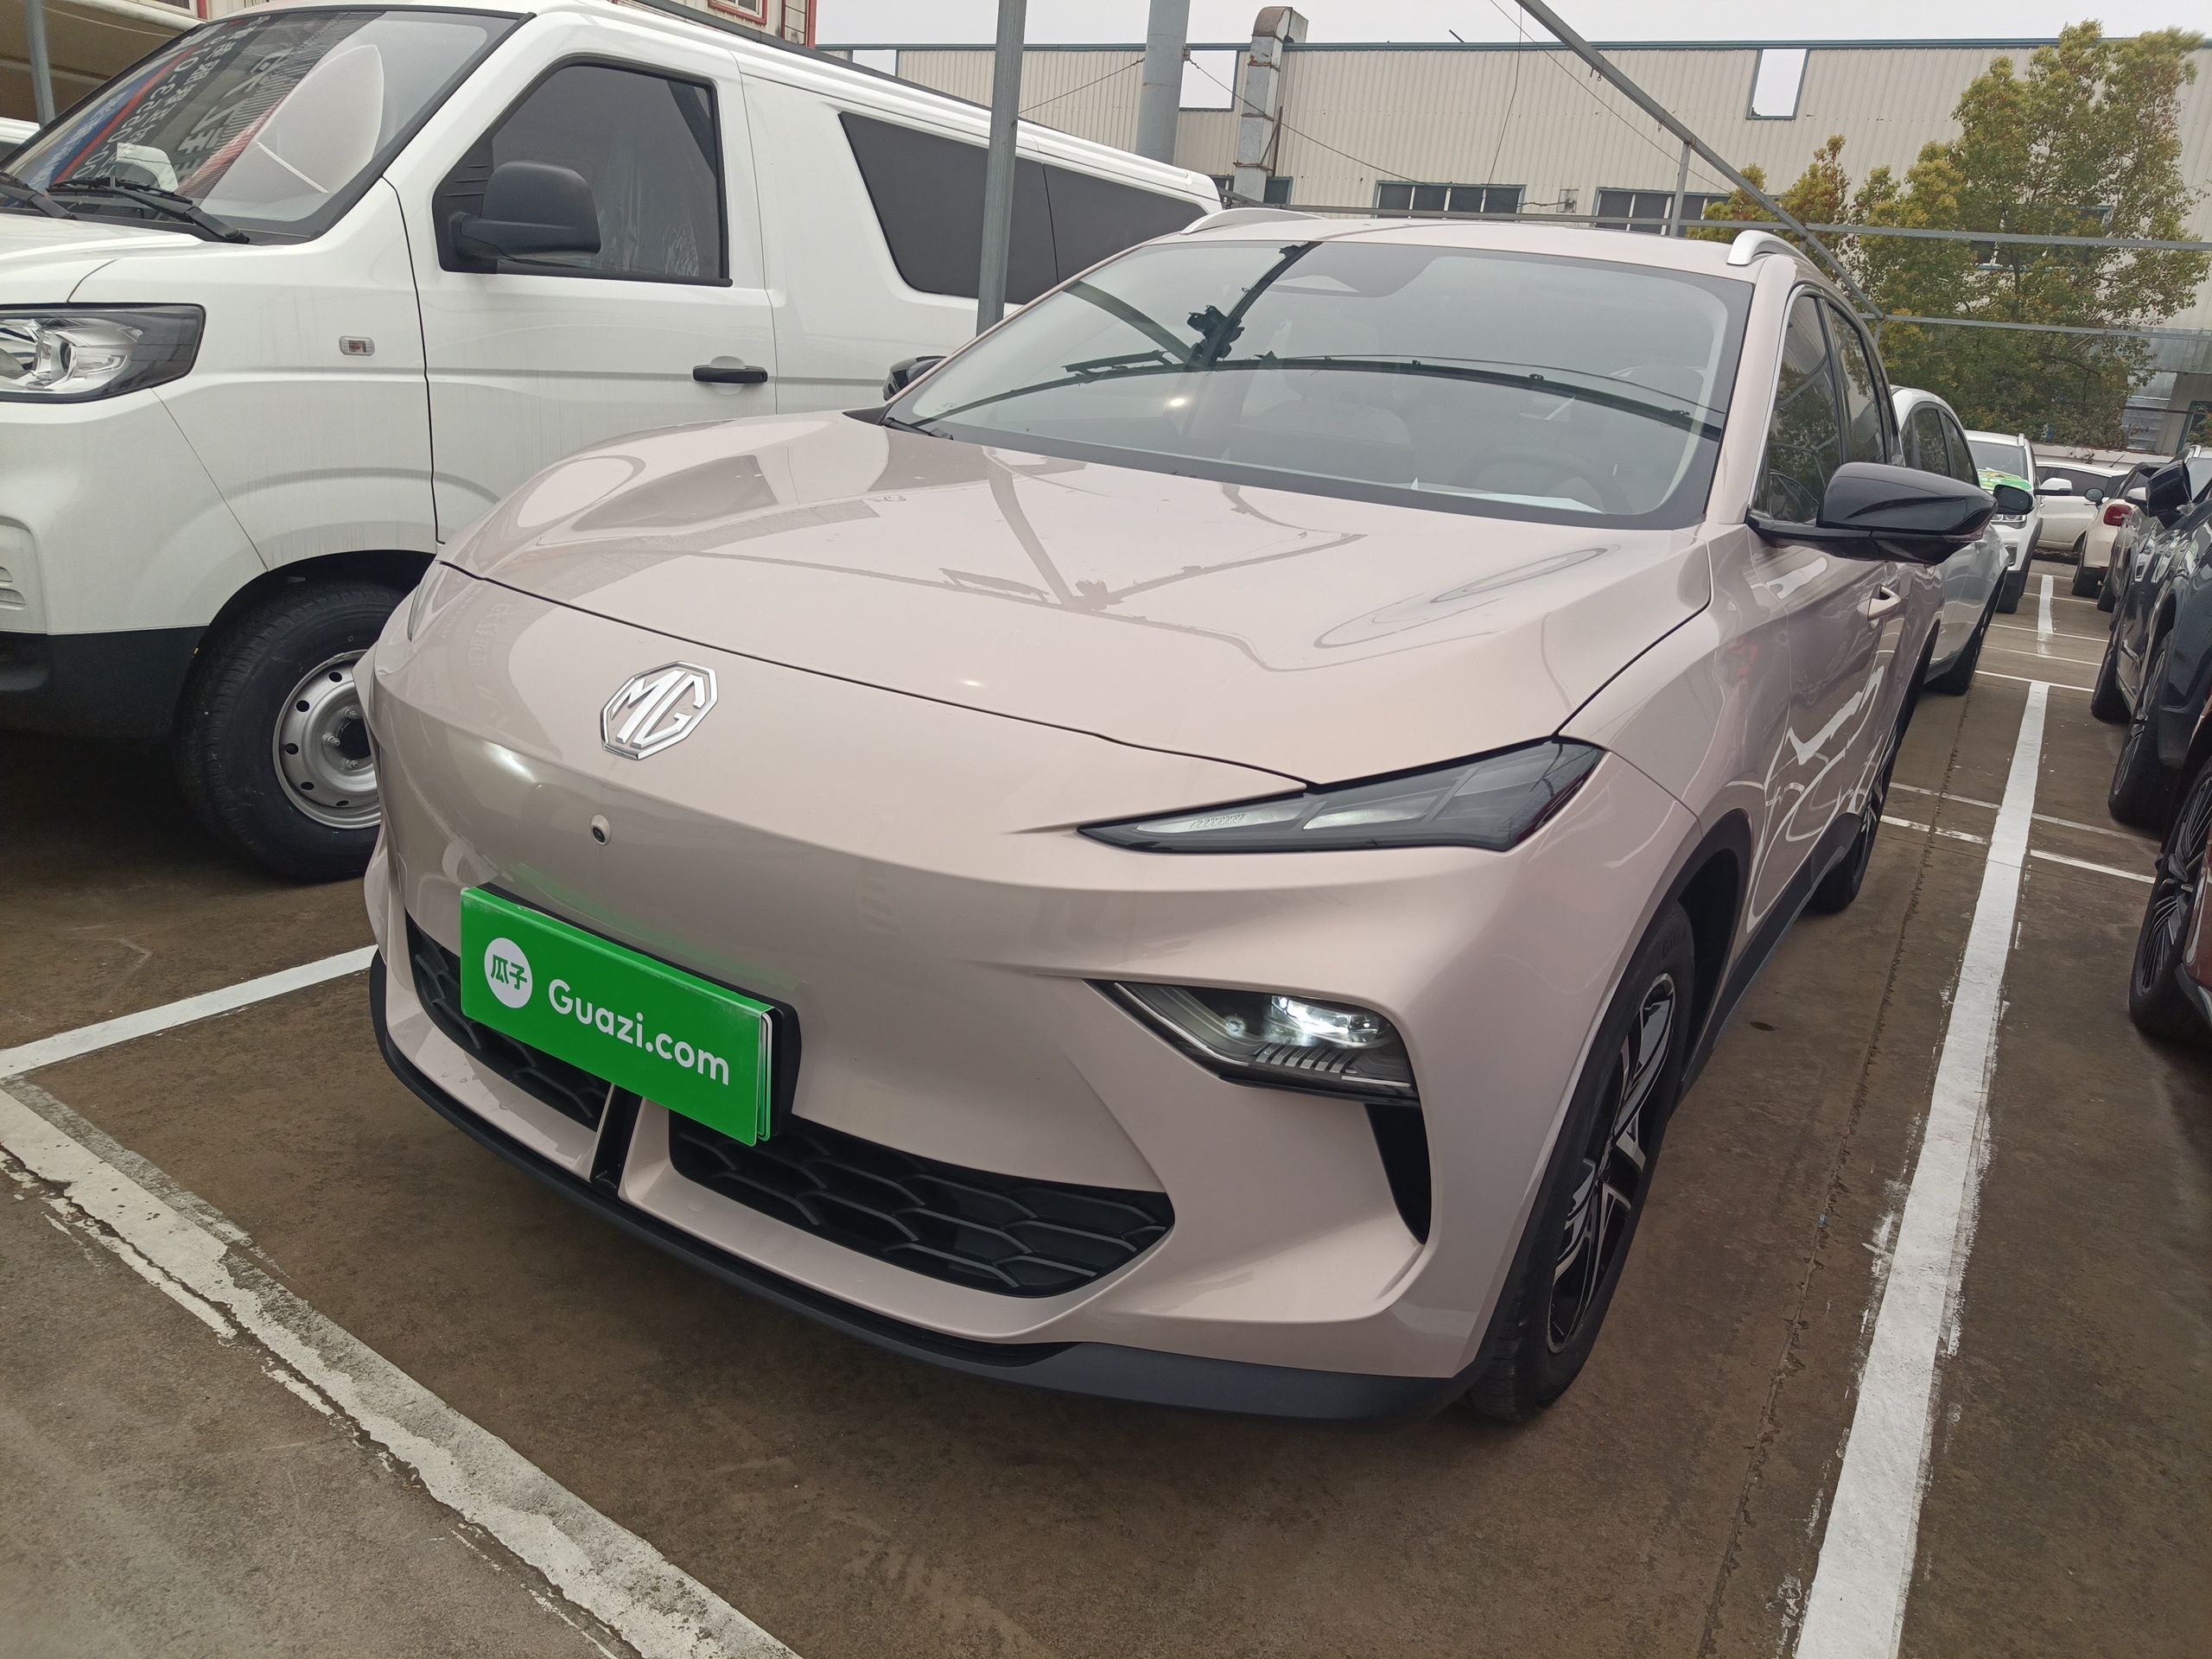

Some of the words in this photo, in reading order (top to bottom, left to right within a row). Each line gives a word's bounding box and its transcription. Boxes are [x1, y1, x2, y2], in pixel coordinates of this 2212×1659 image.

[610, 669, 707, 750] MG
[490, 954, 528, 990] 瓜子
[548, 978, 730, 1086] Guazi.com
